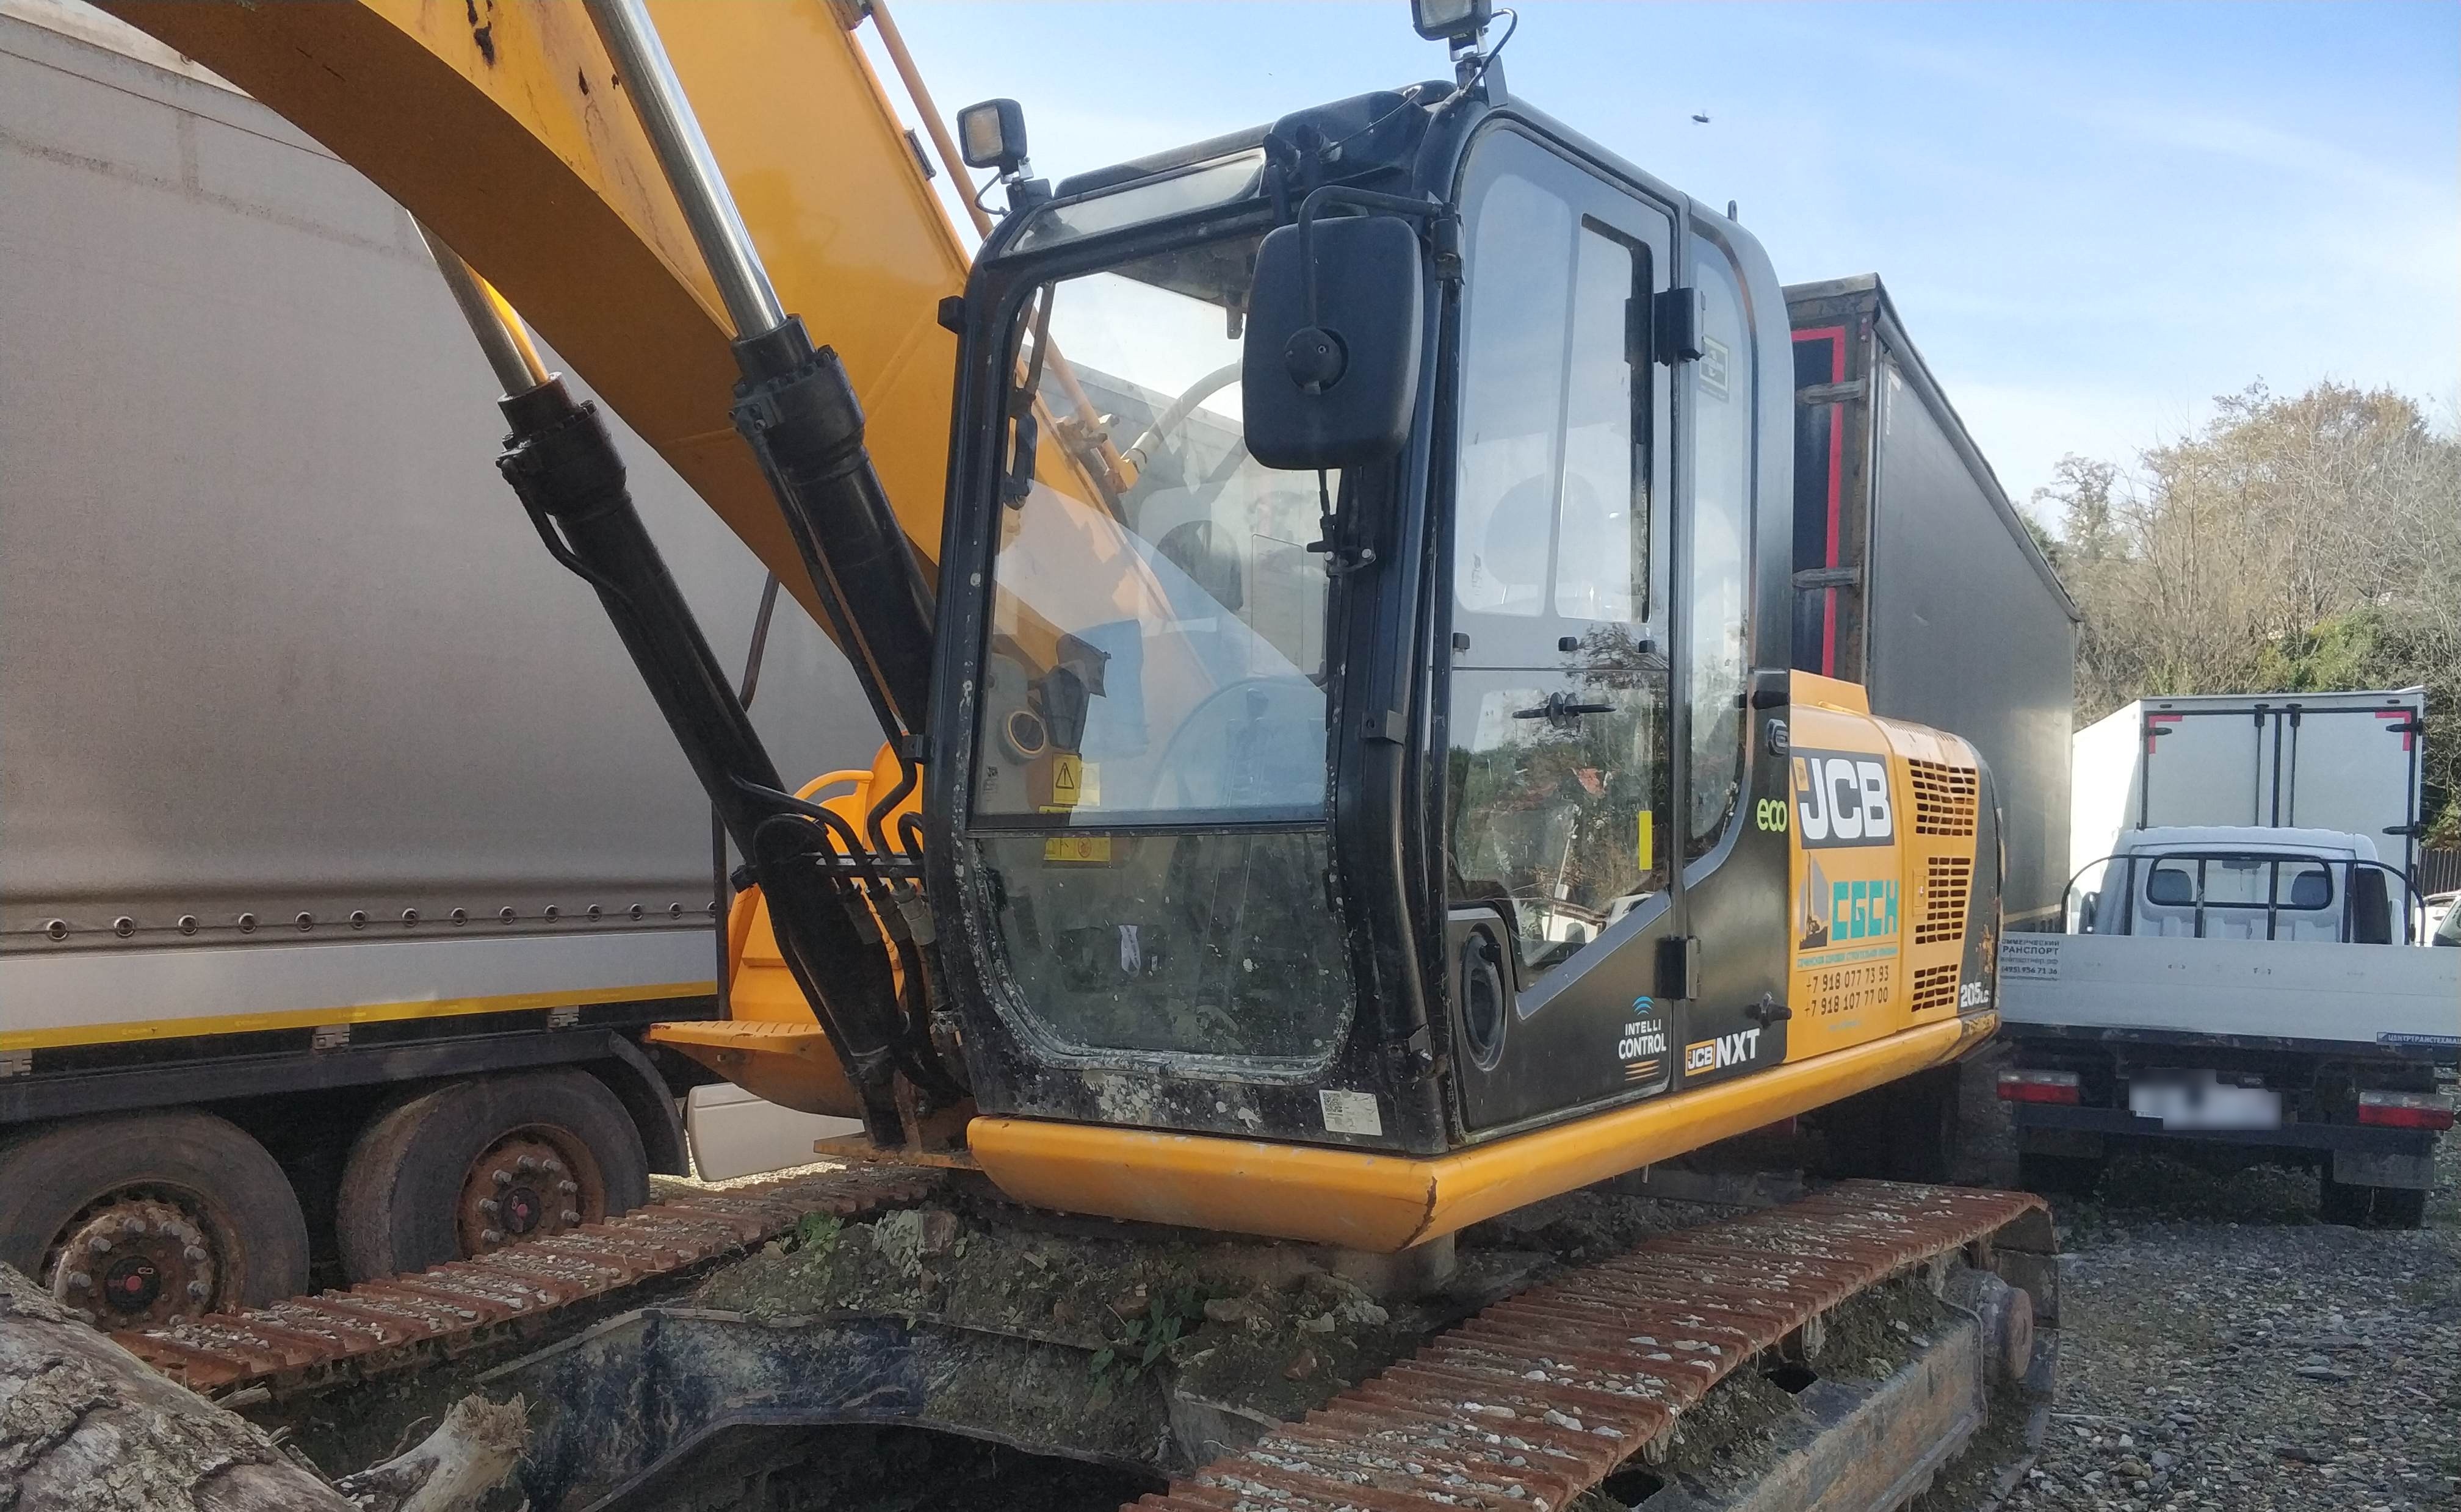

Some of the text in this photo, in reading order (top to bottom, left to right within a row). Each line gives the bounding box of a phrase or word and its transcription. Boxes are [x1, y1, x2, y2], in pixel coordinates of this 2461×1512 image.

[1799, 758, 1892, 840] JCB
[1757, 798, 1787, 832] eco
[2003, 945, 2059, 956] РАНСПОРТ
[1806, 976, 1818, 993] +7
[1823, 972, 1841, 992] 918
[1845, 969, 1862, 988] 077
[1879, 965, 1889, 982] 93
[1804, 987, 1888, 1017] +7 918 107 77 00
[1625, 1018, 1661, 1036] INTELLI
[1618, 1033, 1667, 1059] CONTROL
[1688, 1028, 1760, 1069] JCB NXT
